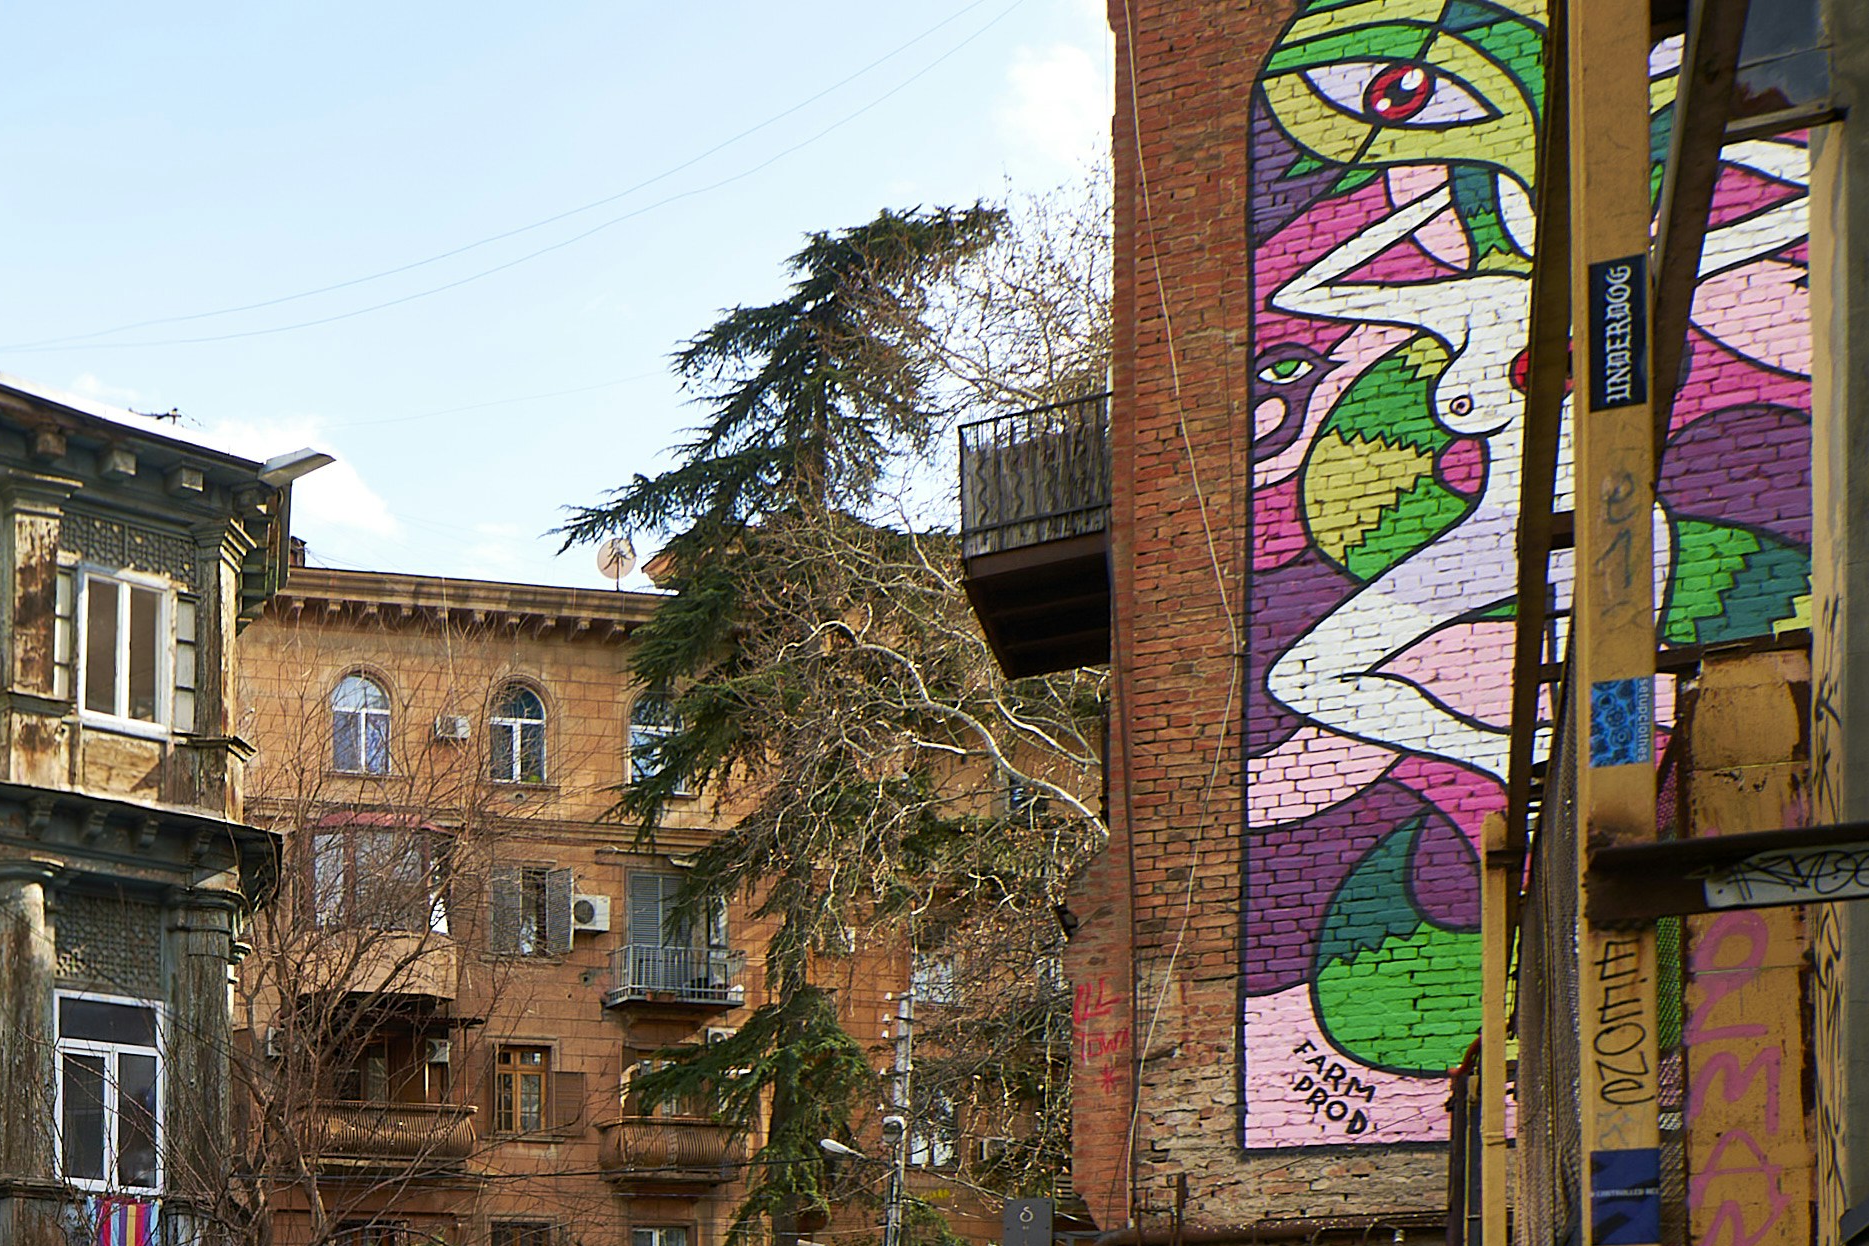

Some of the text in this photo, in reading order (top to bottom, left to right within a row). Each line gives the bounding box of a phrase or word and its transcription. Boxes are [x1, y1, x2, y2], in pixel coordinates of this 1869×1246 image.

[1606, 263, 1633, 405] UNDERDOG
[1292, 1038, 1377, 1104] FARM
[1292, 1074, 1369, 1135] PROD
